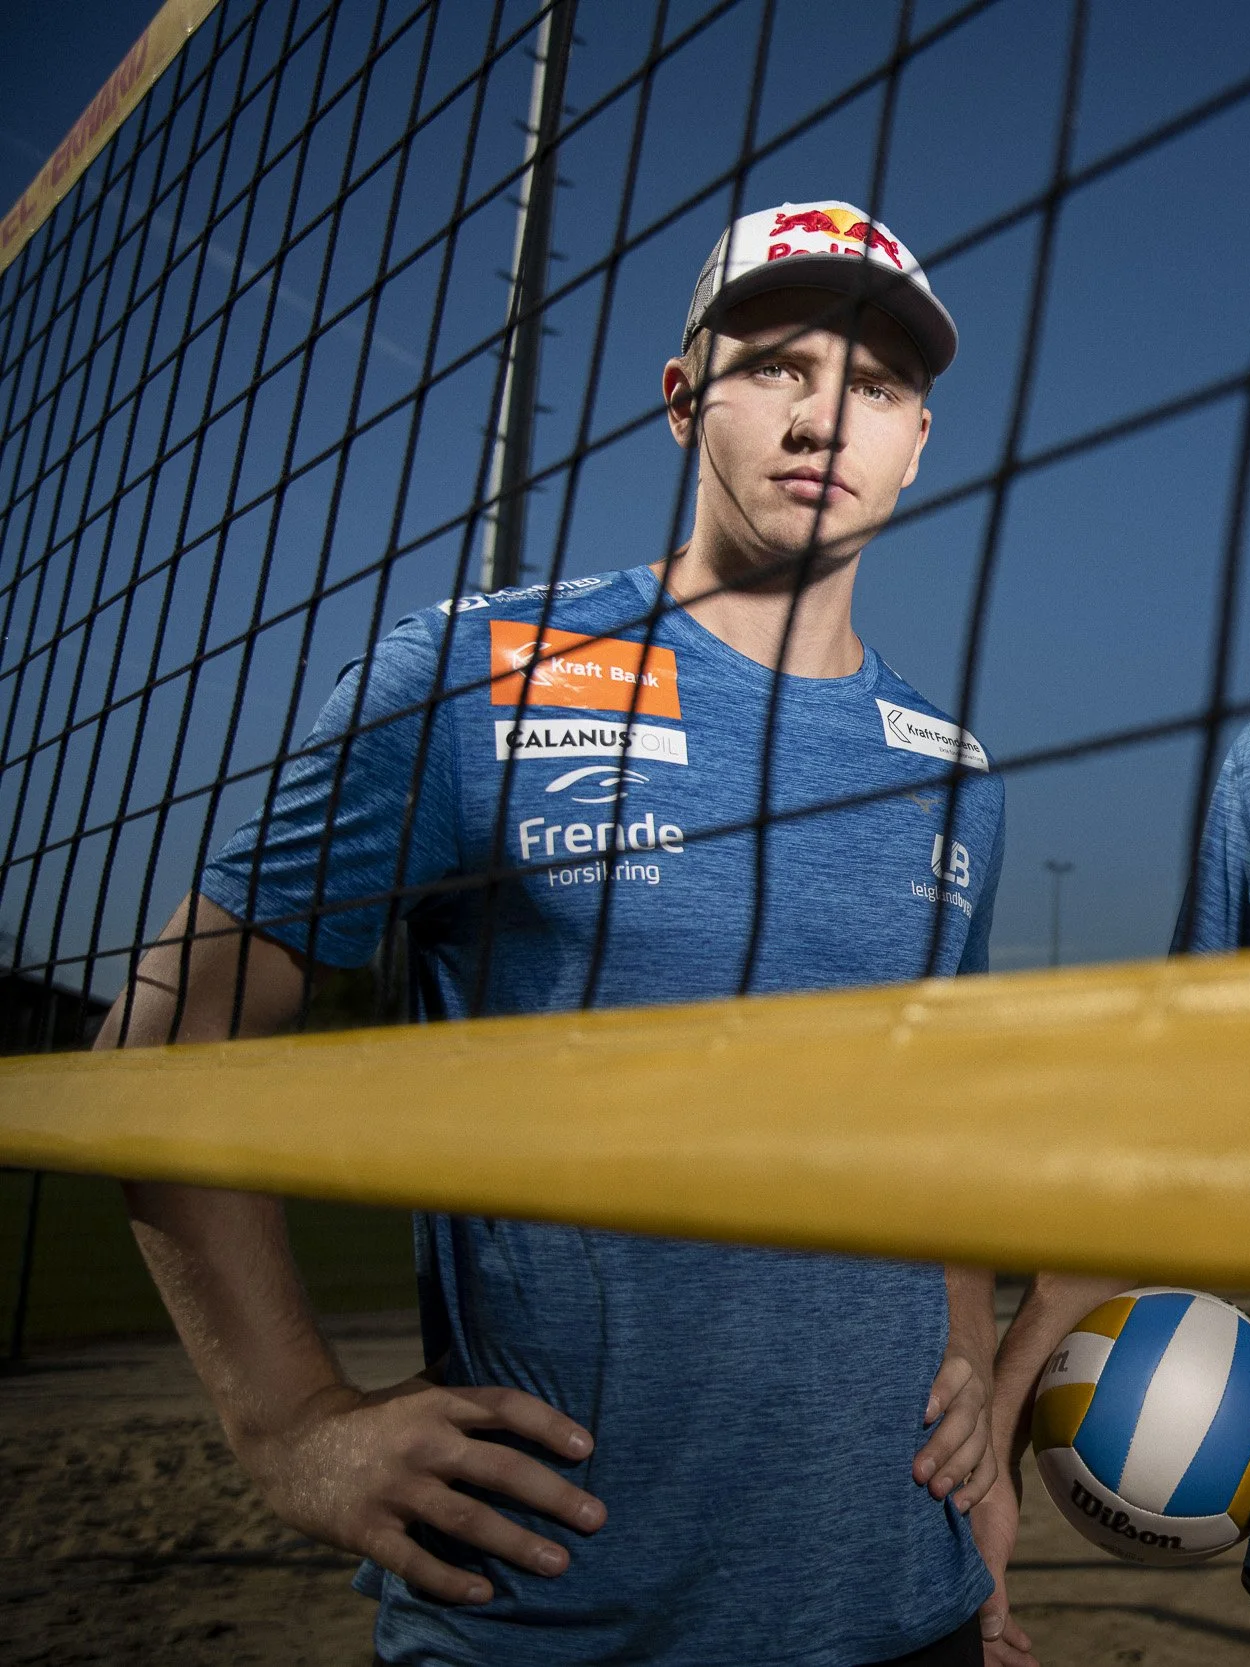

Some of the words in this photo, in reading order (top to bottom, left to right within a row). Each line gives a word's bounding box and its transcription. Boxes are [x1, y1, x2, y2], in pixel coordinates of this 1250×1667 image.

[551, 657, 602, 678] Kraft
[506, 729, 632, 749] CALANUS
[641, 733, 679, 756] OIL
[906, 723, 933, 741] Kraft
[935, 733, 980, 753] Fondene
[519, 812, 684, 860] Frende
[1070, 1479, 1184, 1549] Wilson
